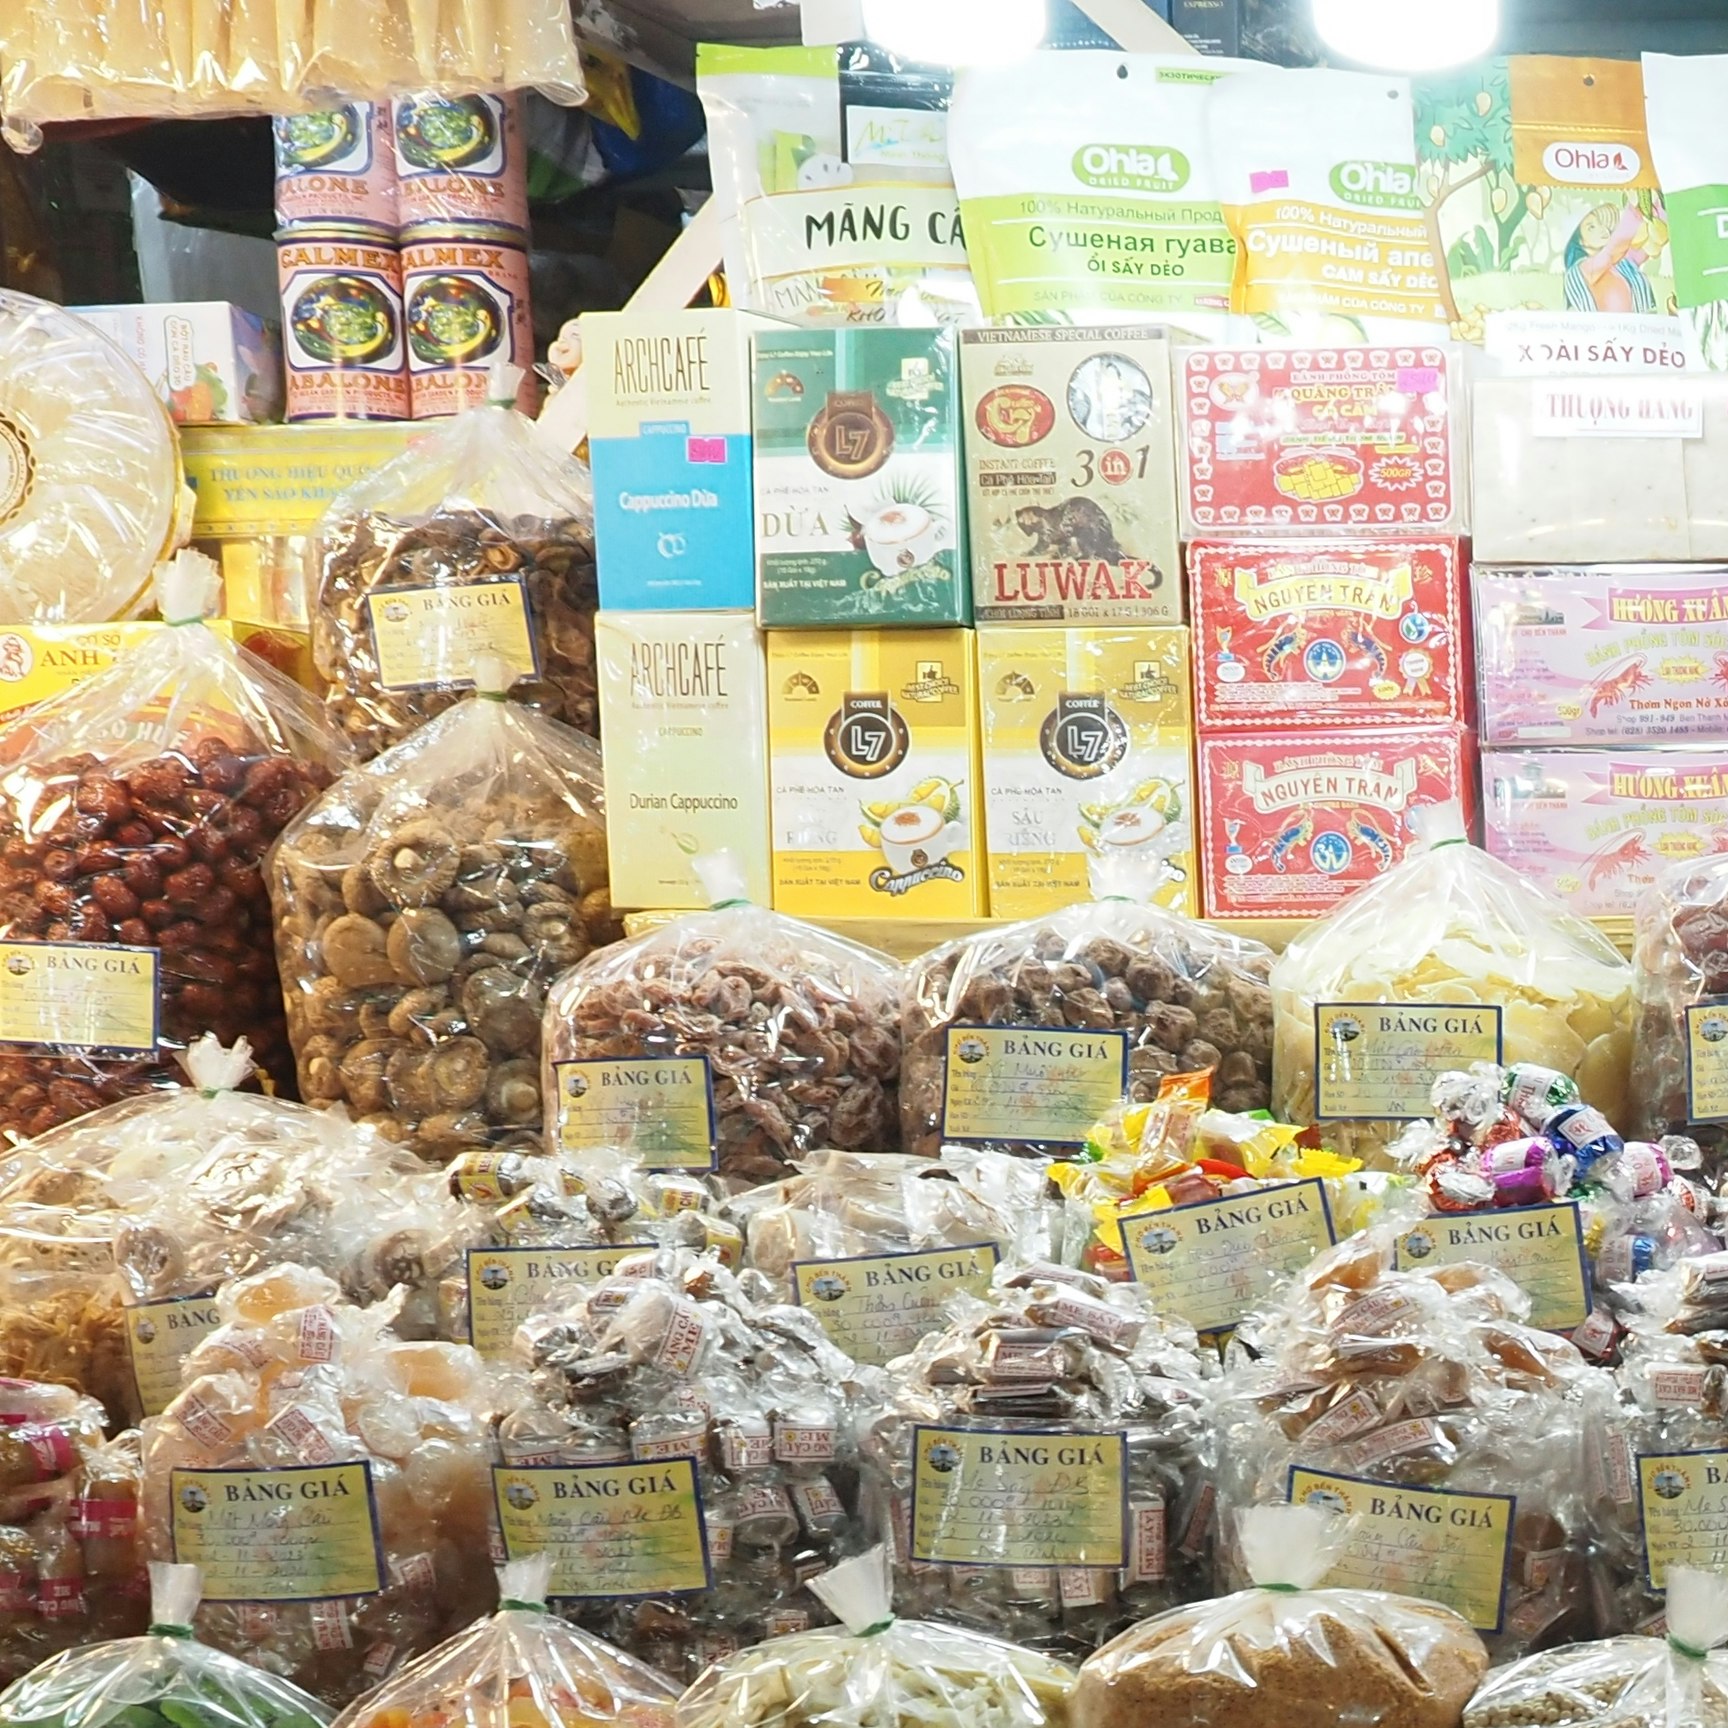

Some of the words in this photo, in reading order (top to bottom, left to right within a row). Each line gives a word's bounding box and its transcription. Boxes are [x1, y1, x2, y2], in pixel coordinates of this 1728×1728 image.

[1082, 146, 1151, 179] Ohla
[1554, 148, 1610, 170] Ohla
[1029, 226, 1154, 253] Сушеная
[1248, 228, 1380, 264] Сушеный
[1112, 257, 1144, 274] SẤY
[976, 329, 1050, 343] VIETNAMESE
[1053, 329, 1102, 343] SPECIAL
[1105, 328, 1149, 342] COFFEE
[614, 327, 710, 396] ARCHCAFÉ
[761, 507, 830, 538] DỪA
[994, 561, 1154, 603] LUWAK
[631, 633, 729, 699] ARCHCAFÉ
[1664, 699, 1693, 710] Ngon
[630, 794, 664, 811] Durian
[668, 793, 739, 813] Cappuccino
[868, 862, 966, 896] Cappuccino
[1380, 1012, 1438, 1033] BẢNG
[1445, 1014, 1484, 1034] GIÁ
[1003, 1035, 1063, 1059] BẢNG
[1069, 1037, 1109, 1060] GIÁ
